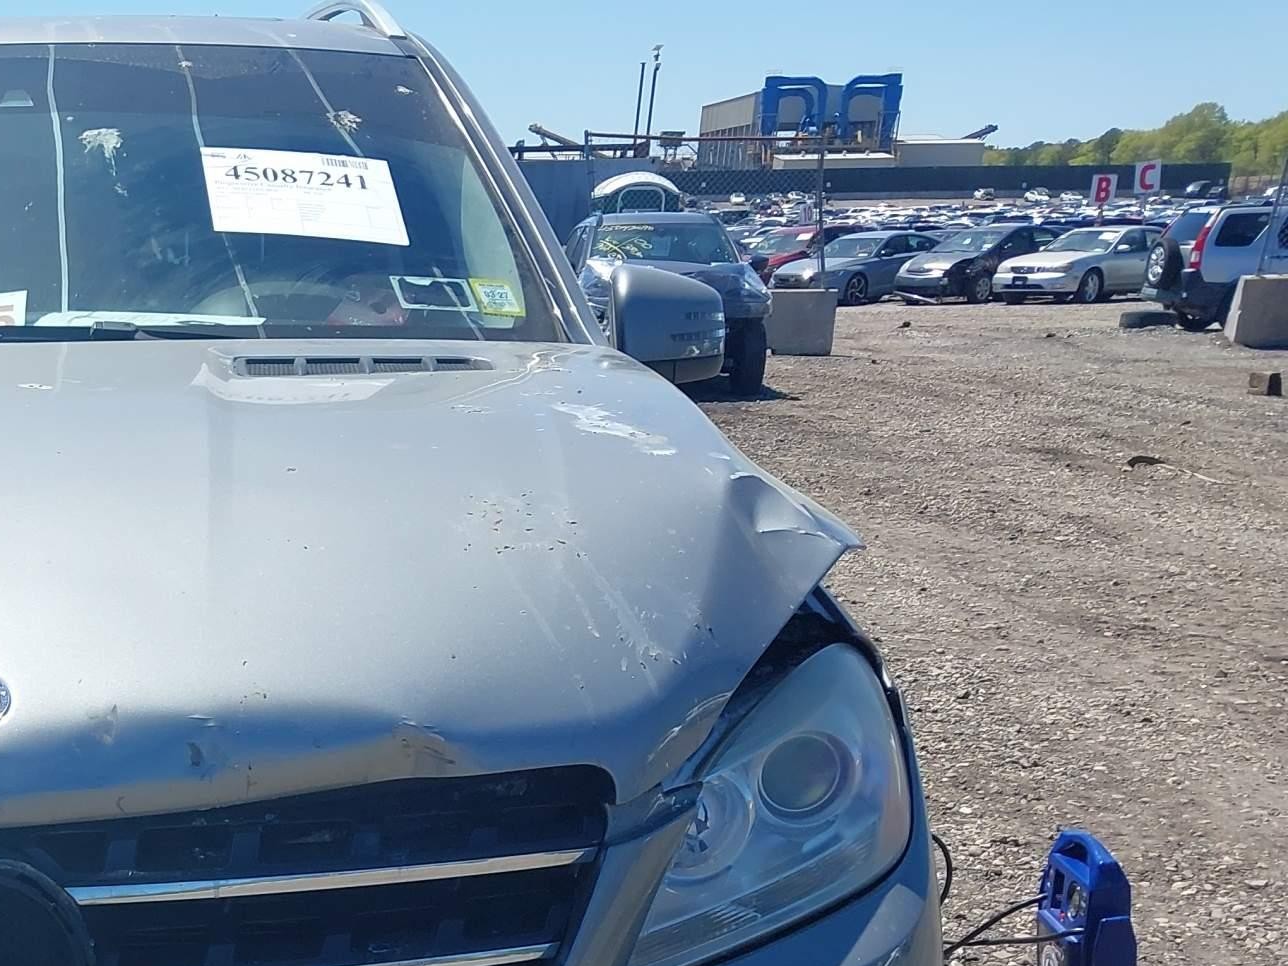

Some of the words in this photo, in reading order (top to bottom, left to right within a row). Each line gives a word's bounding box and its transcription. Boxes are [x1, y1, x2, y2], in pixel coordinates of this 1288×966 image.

[225, 165, 368, 190] 45087241
[1095, 176, 1111, 202] B
[1139, 164, 1156, 190] C
